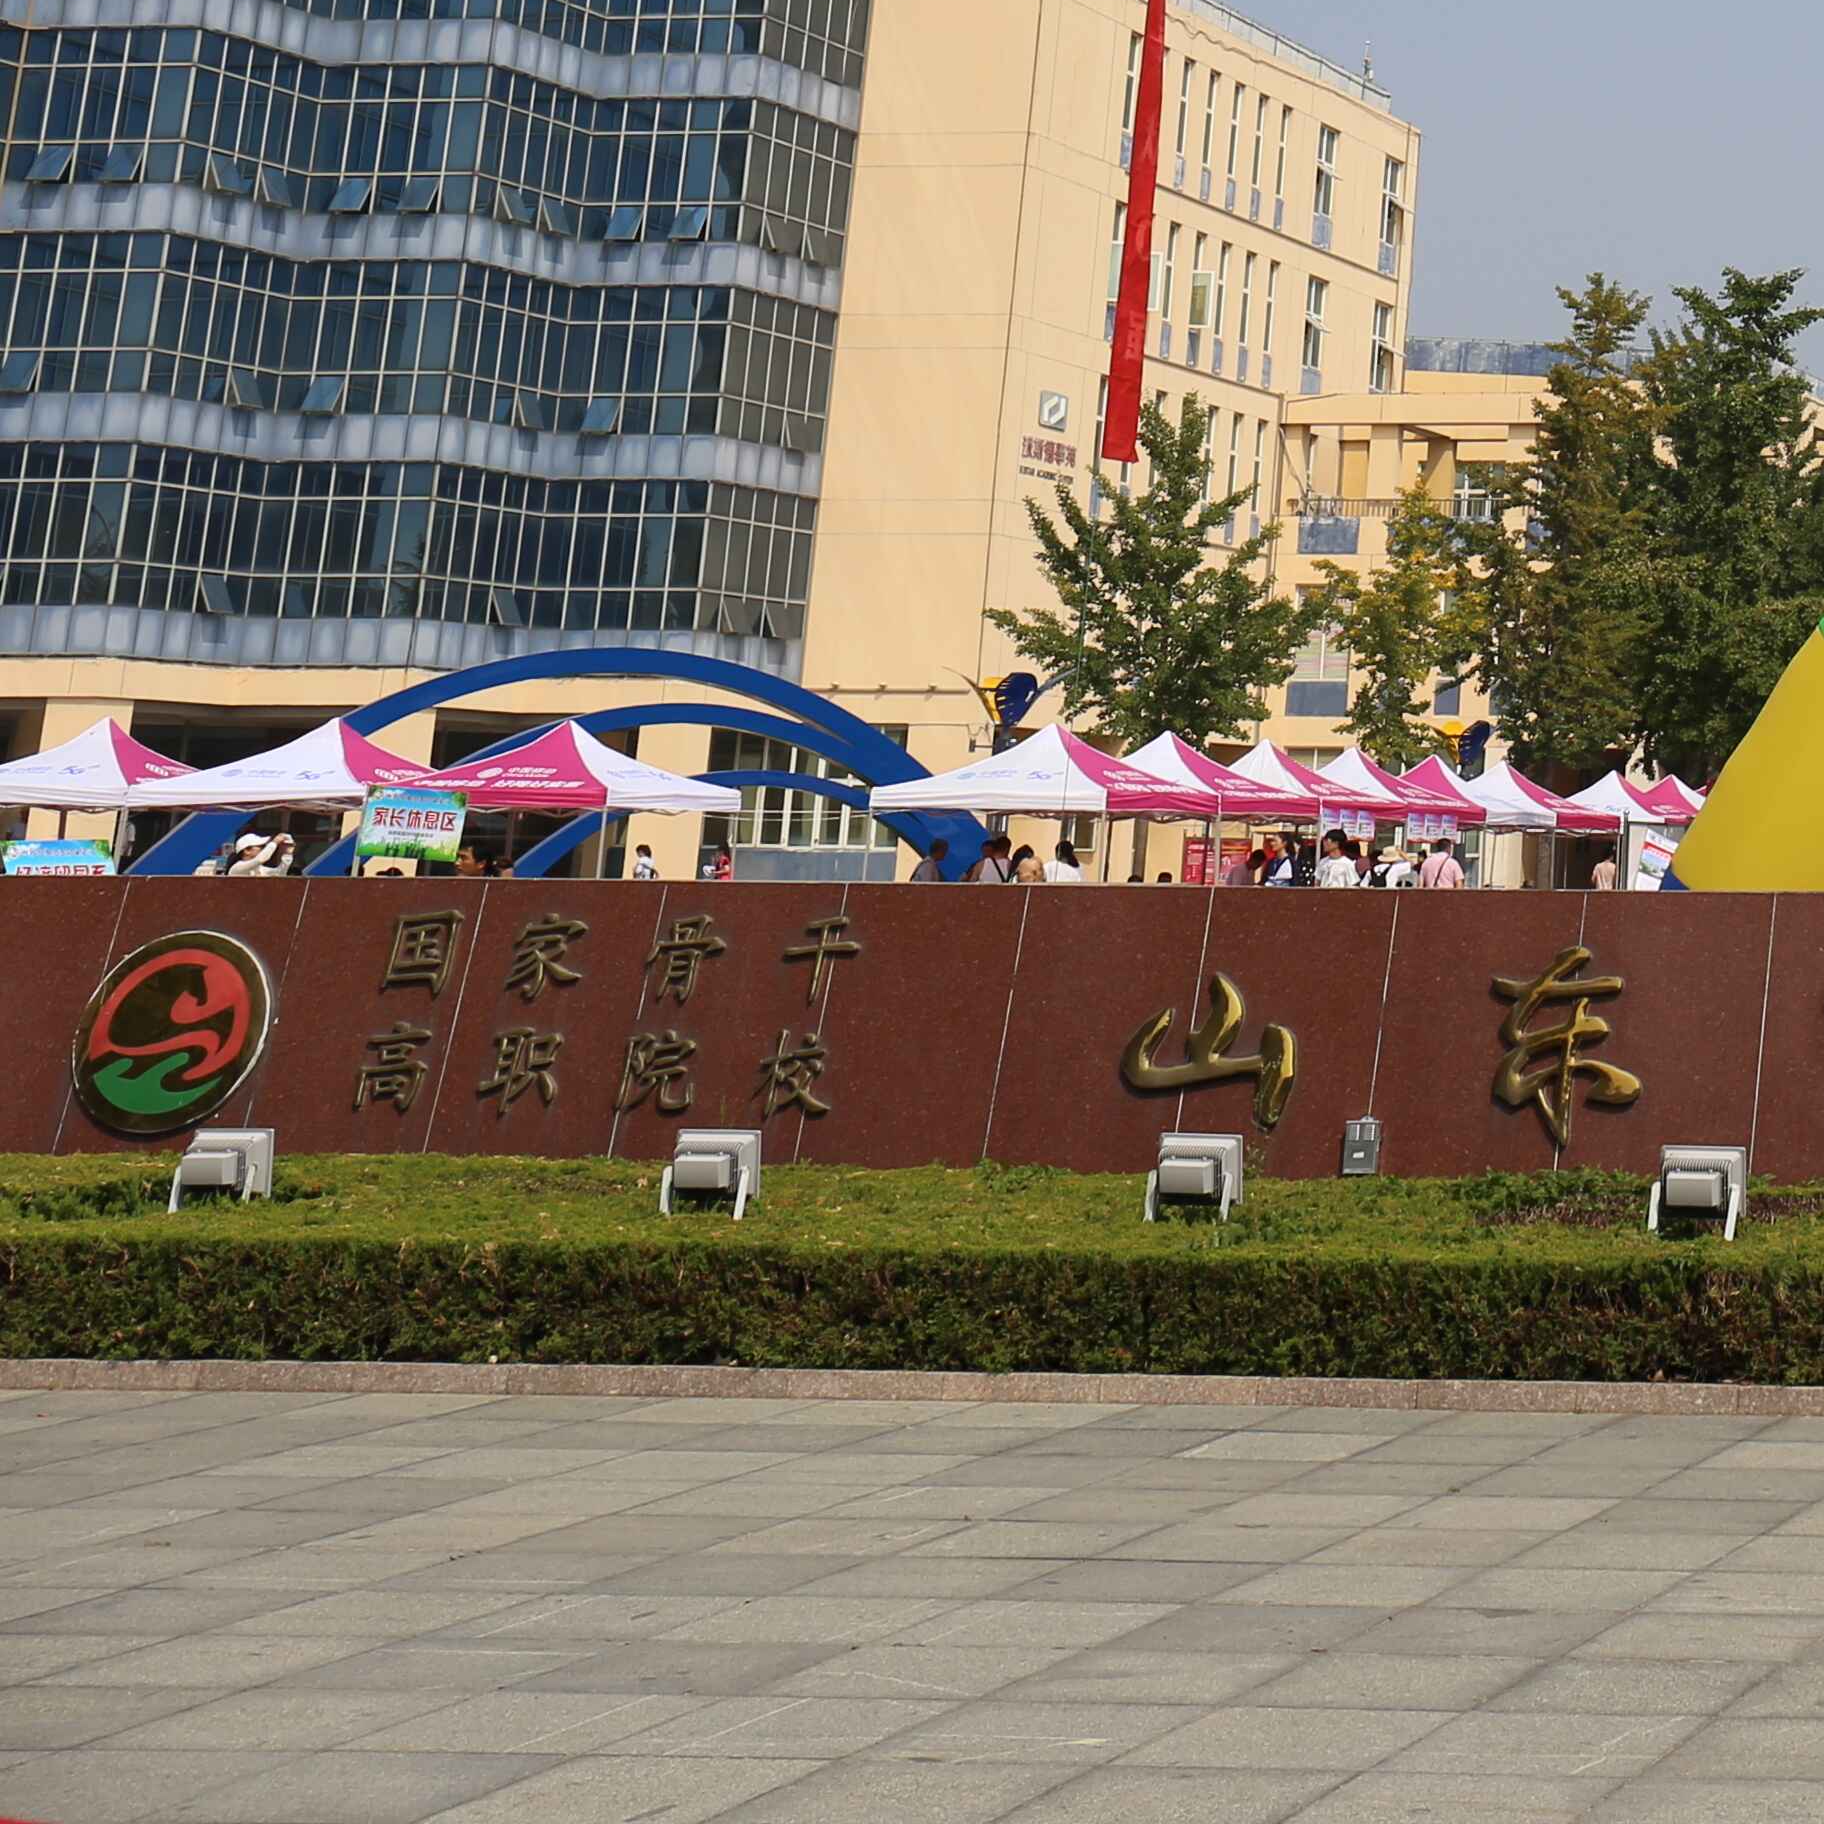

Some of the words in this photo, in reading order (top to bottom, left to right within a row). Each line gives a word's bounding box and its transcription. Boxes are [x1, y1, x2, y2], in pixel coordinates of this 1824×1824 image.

[372, 807, 458, 833] 家长休息区
[380, 908, 863, 1007] 国家骨干
[352, 1021, 832, 1119] 高职院校
